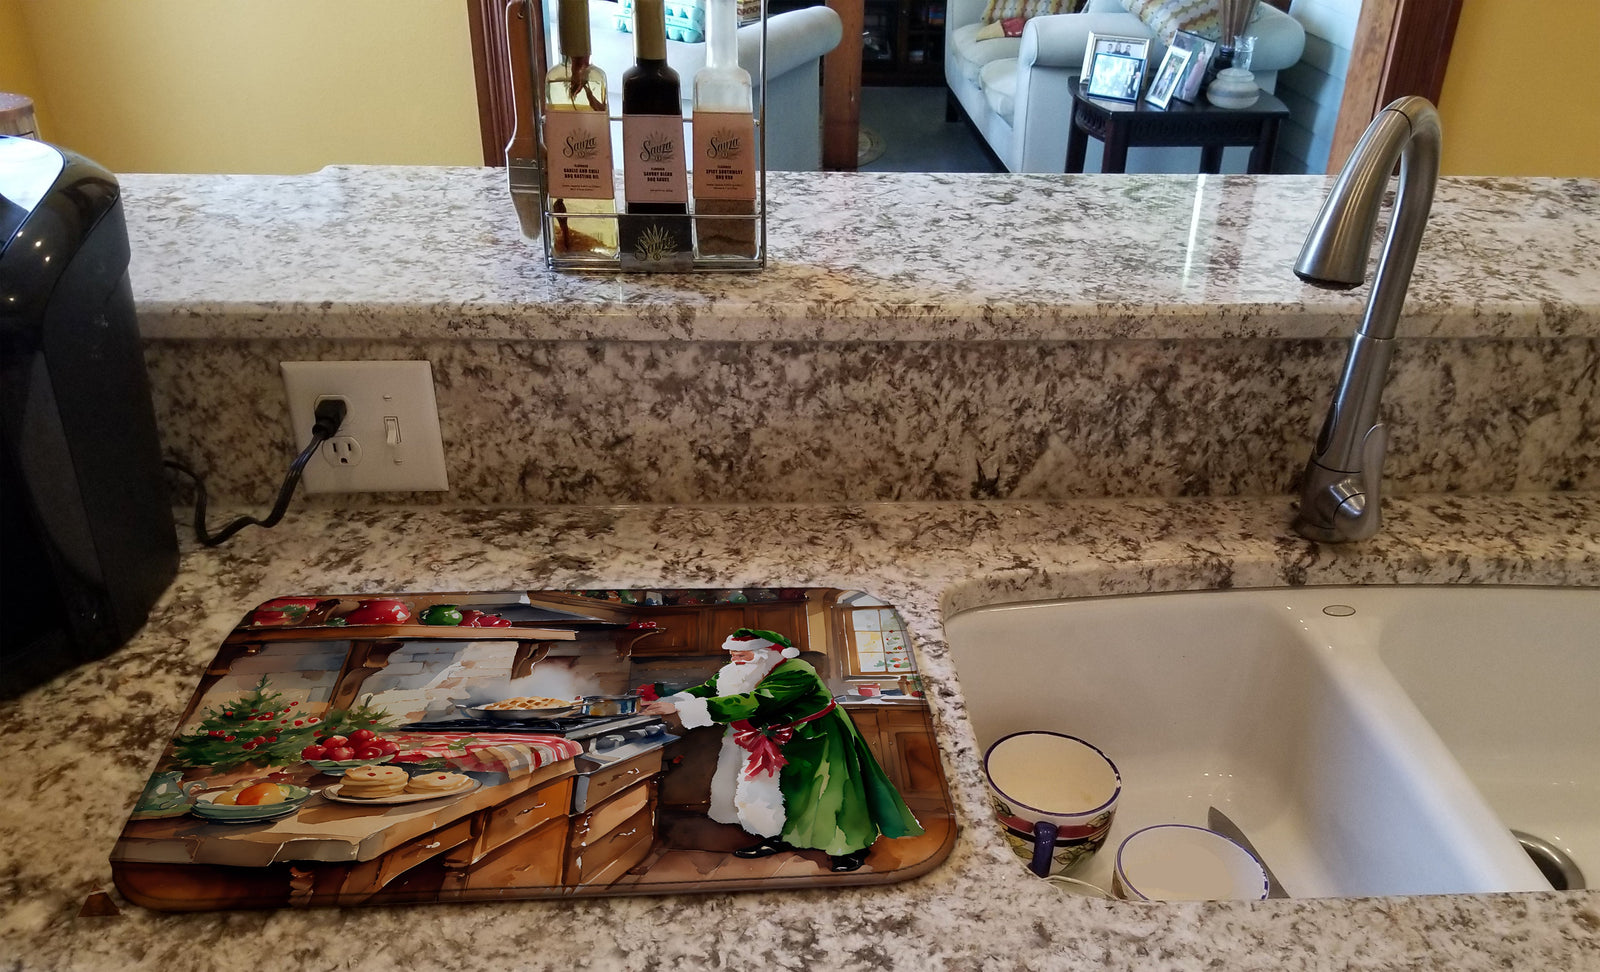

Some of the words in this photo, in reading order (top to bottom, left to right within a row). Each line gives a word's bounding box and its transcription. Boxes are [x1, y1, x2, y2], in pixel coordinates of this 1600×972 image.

[562, 136, 597, 159] Sauza
[640, 140, 674, 162] Sauza
[706, 136, 740, 159] Sauza
